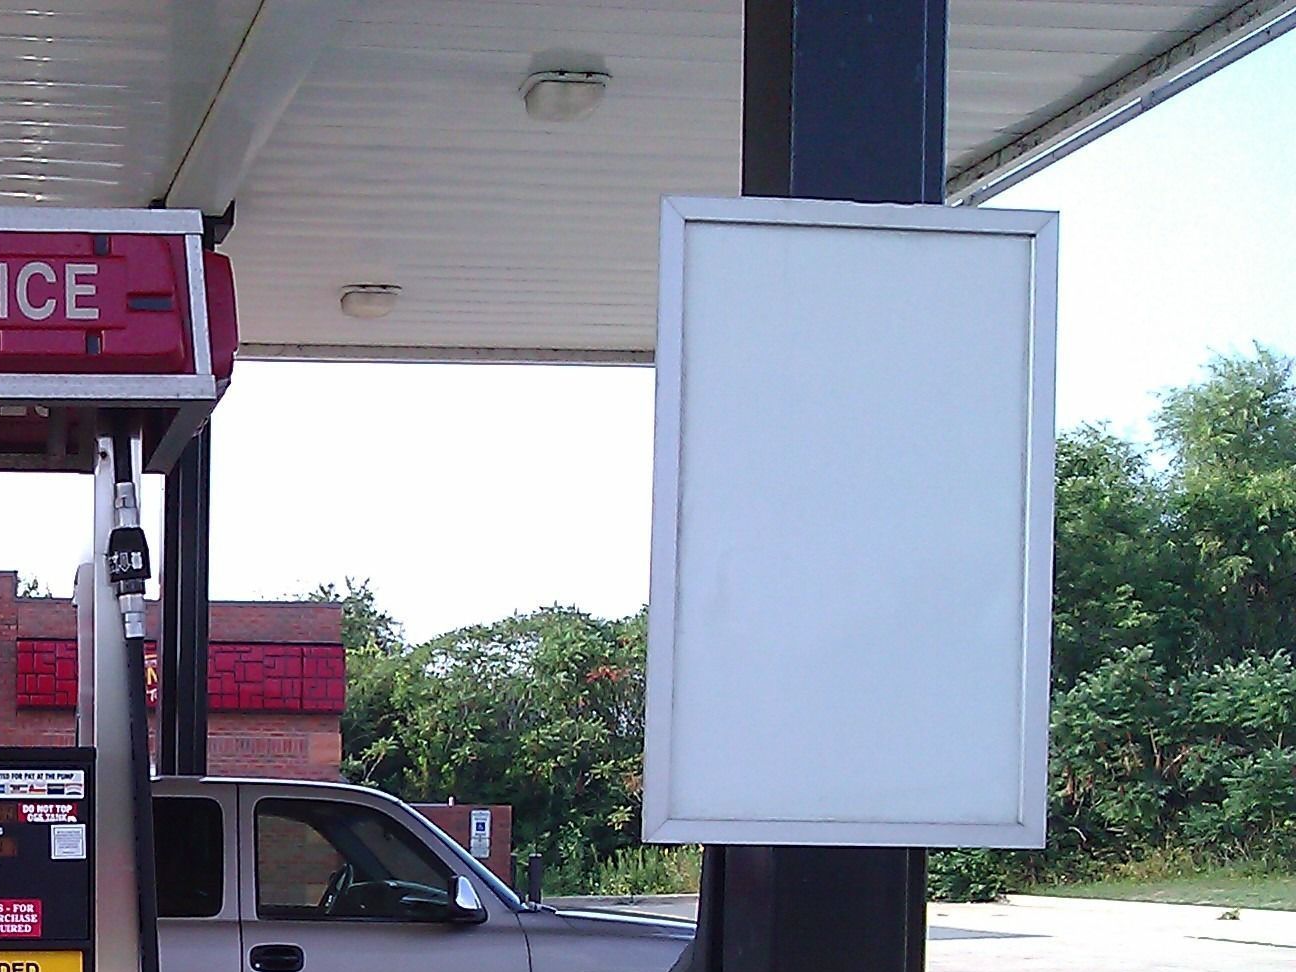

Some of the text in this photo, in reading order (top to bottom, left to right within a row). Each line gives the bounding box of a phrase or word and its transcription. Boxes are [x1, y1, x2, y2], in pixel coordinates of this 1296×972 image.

[22, 804, 35, 814] DO
[36, 804, 54, 814] NOT
[55, 804, 73, 814] TOP
[12, 903, 35, 913] FOR
